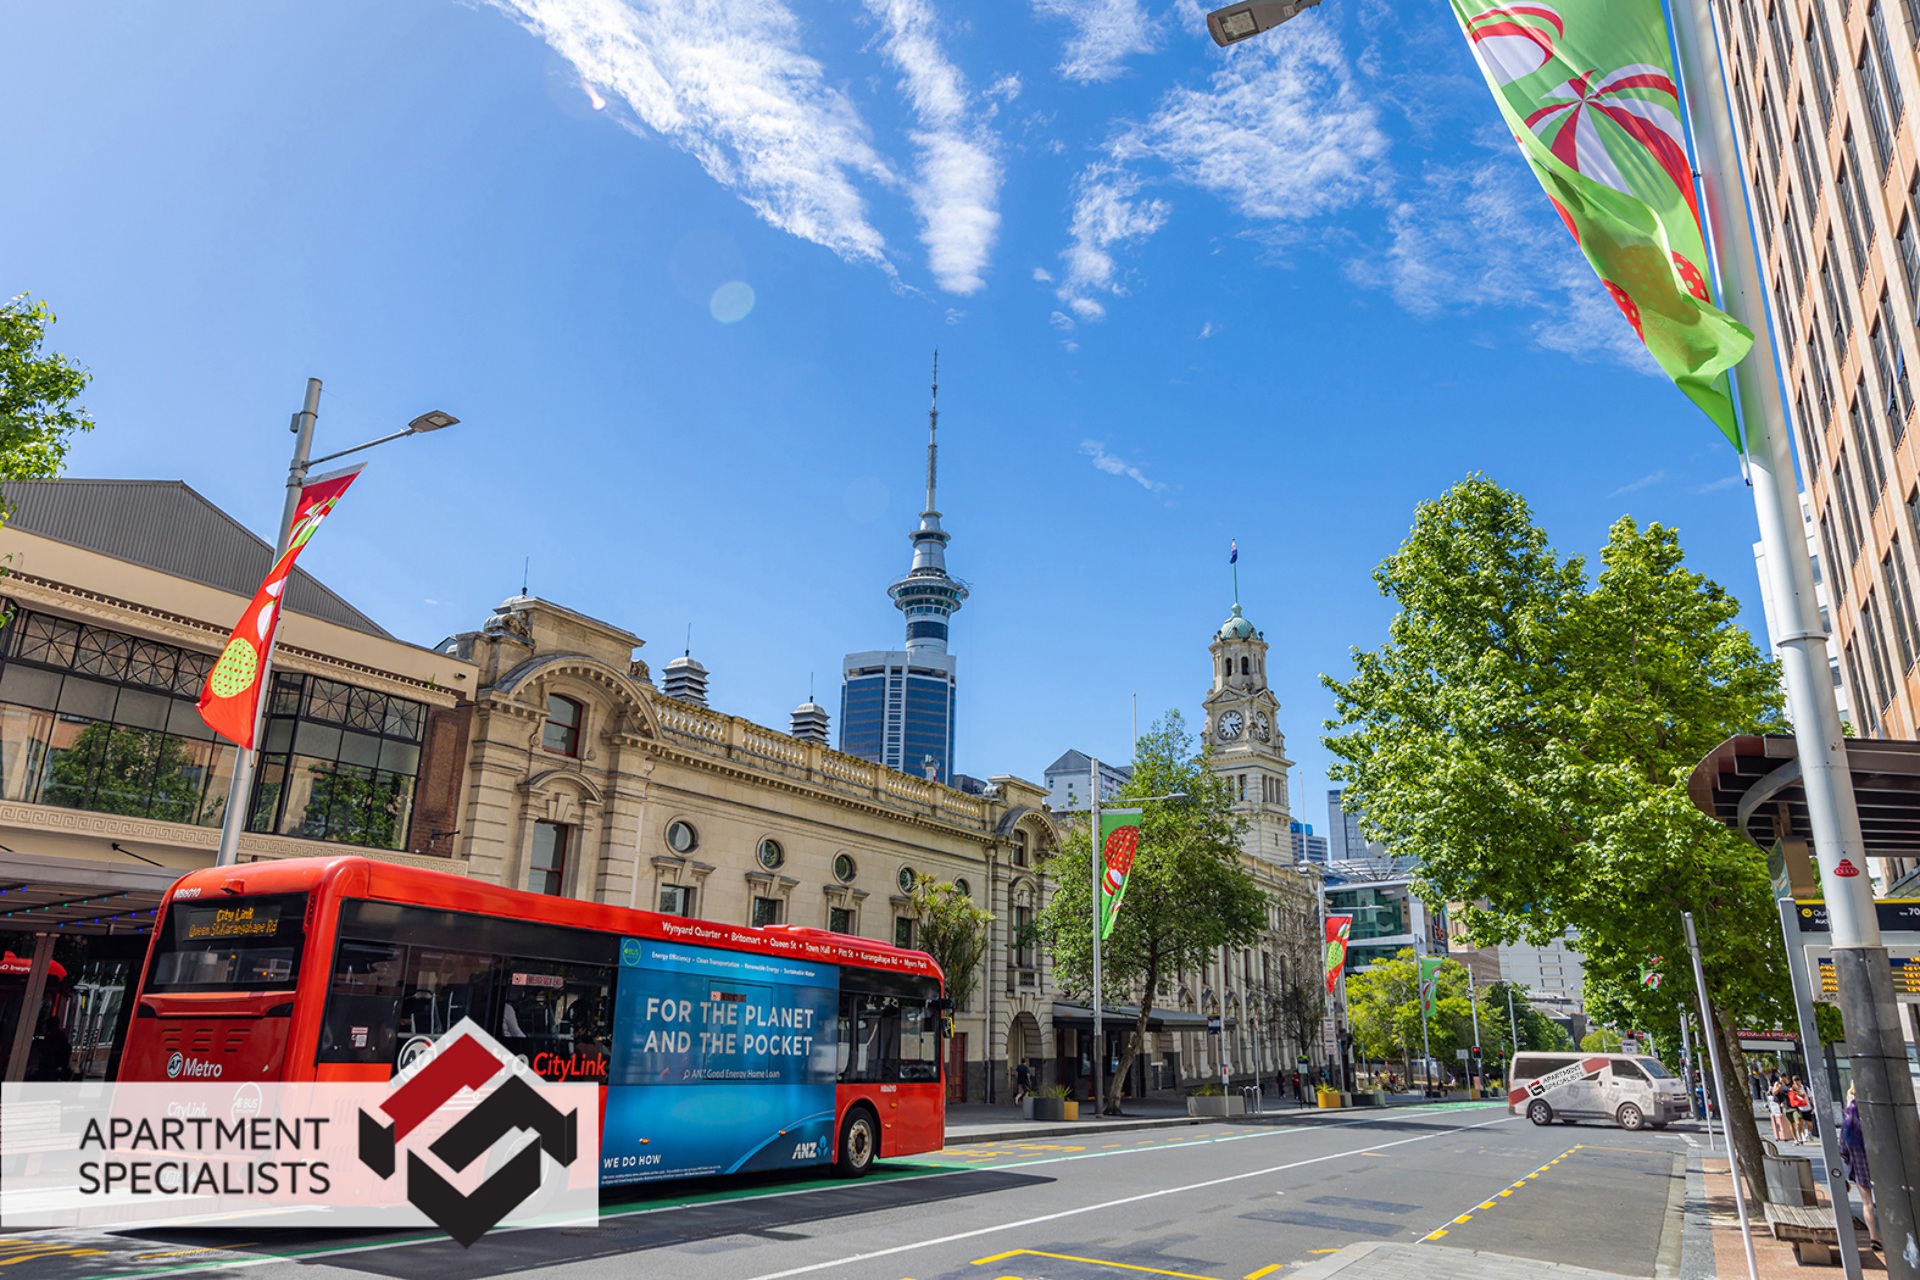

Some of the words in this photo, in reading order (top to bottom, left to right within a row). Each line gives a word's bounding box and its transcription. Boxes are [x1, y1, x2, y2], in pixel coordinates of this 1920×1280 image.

[216, 908, 234, 922] City
[235, 907, 254, 920] Link
[266, 919, 278, 934] Rd
[662, 921, 693, 936] Wynyard
[695, 927, 721, 940] Quarter
[731, 932, 761, 945] Britomart
[770, 938, 789, 949] Queen
[790, 941, 796, 950] St
[805, 942, 819, 953] Town
[820, 945, 831, 954] Hall
[861, 952, 890, 965] Karangahape
[891, 956, 898, 965] Rd
[917, 961, 927, 969] Park
[652, 951, 669, 961] Energy
[669, 953, 691, 963] Efficiency
[709, 958, 740, 968] Transportation
[646, 998, 691, 1023] FOR
[700, 1002, 738, 1025] THE
[745, 1005, 813, 1029] PLANET
[643, 1030, 691, 1053] AND
[699, 1032, 737, 1054] THE
[744, 1034, 813, 1056] POCKET
[183, 1058, 222, 1078] Metro
[533, 1052, 607, 1083] CityLink
[706, 1068, 725, 1079] Good
[725, 1068, 746, 1080] Energy
[747, 1069, 764, 1079] Home
[766, 1069, 780, 1079] Loan
[1543, 1064, 1581, 1084] APARTMENT
[167, 1101, 207, 1120] CityLink
[792, 1142, 817, 1160] ANZ
[604, 1157, 619, 1168] WE
[622, 1156, 636, 1167] DO
[639, 1154, 661, 1165] HOW
